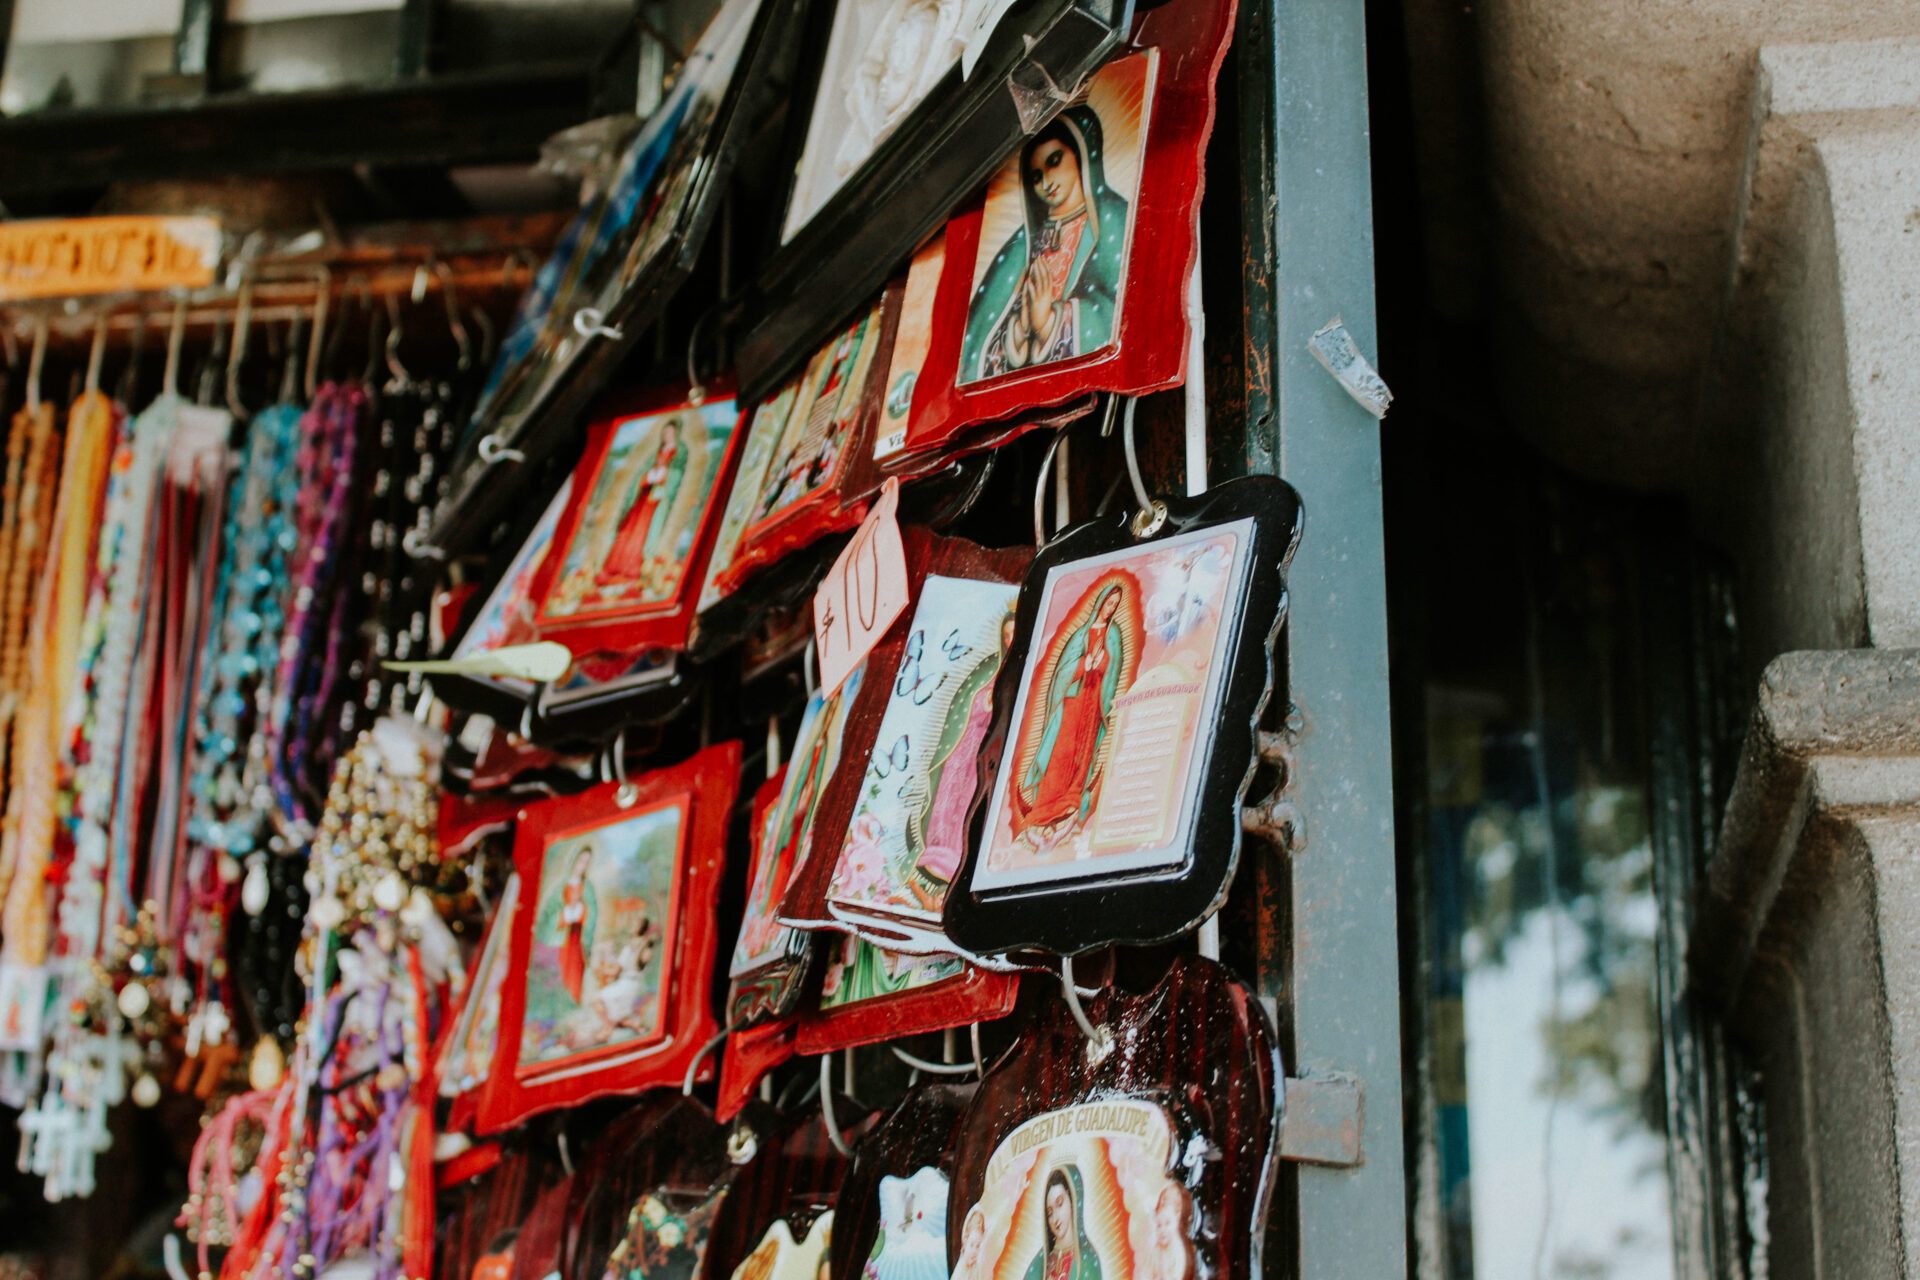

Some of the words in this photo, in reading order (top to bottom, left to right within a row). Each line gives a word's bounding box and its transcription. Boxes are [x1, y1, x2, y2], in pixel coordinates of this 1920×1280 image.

[819, 516, 880, 658] $10
[1010, 1115, 1055, 1156] VIRGEN
[1056, 1109, 1074, 1137] DE
[1075, 1105, 1150, 1136] GUADALUPE
